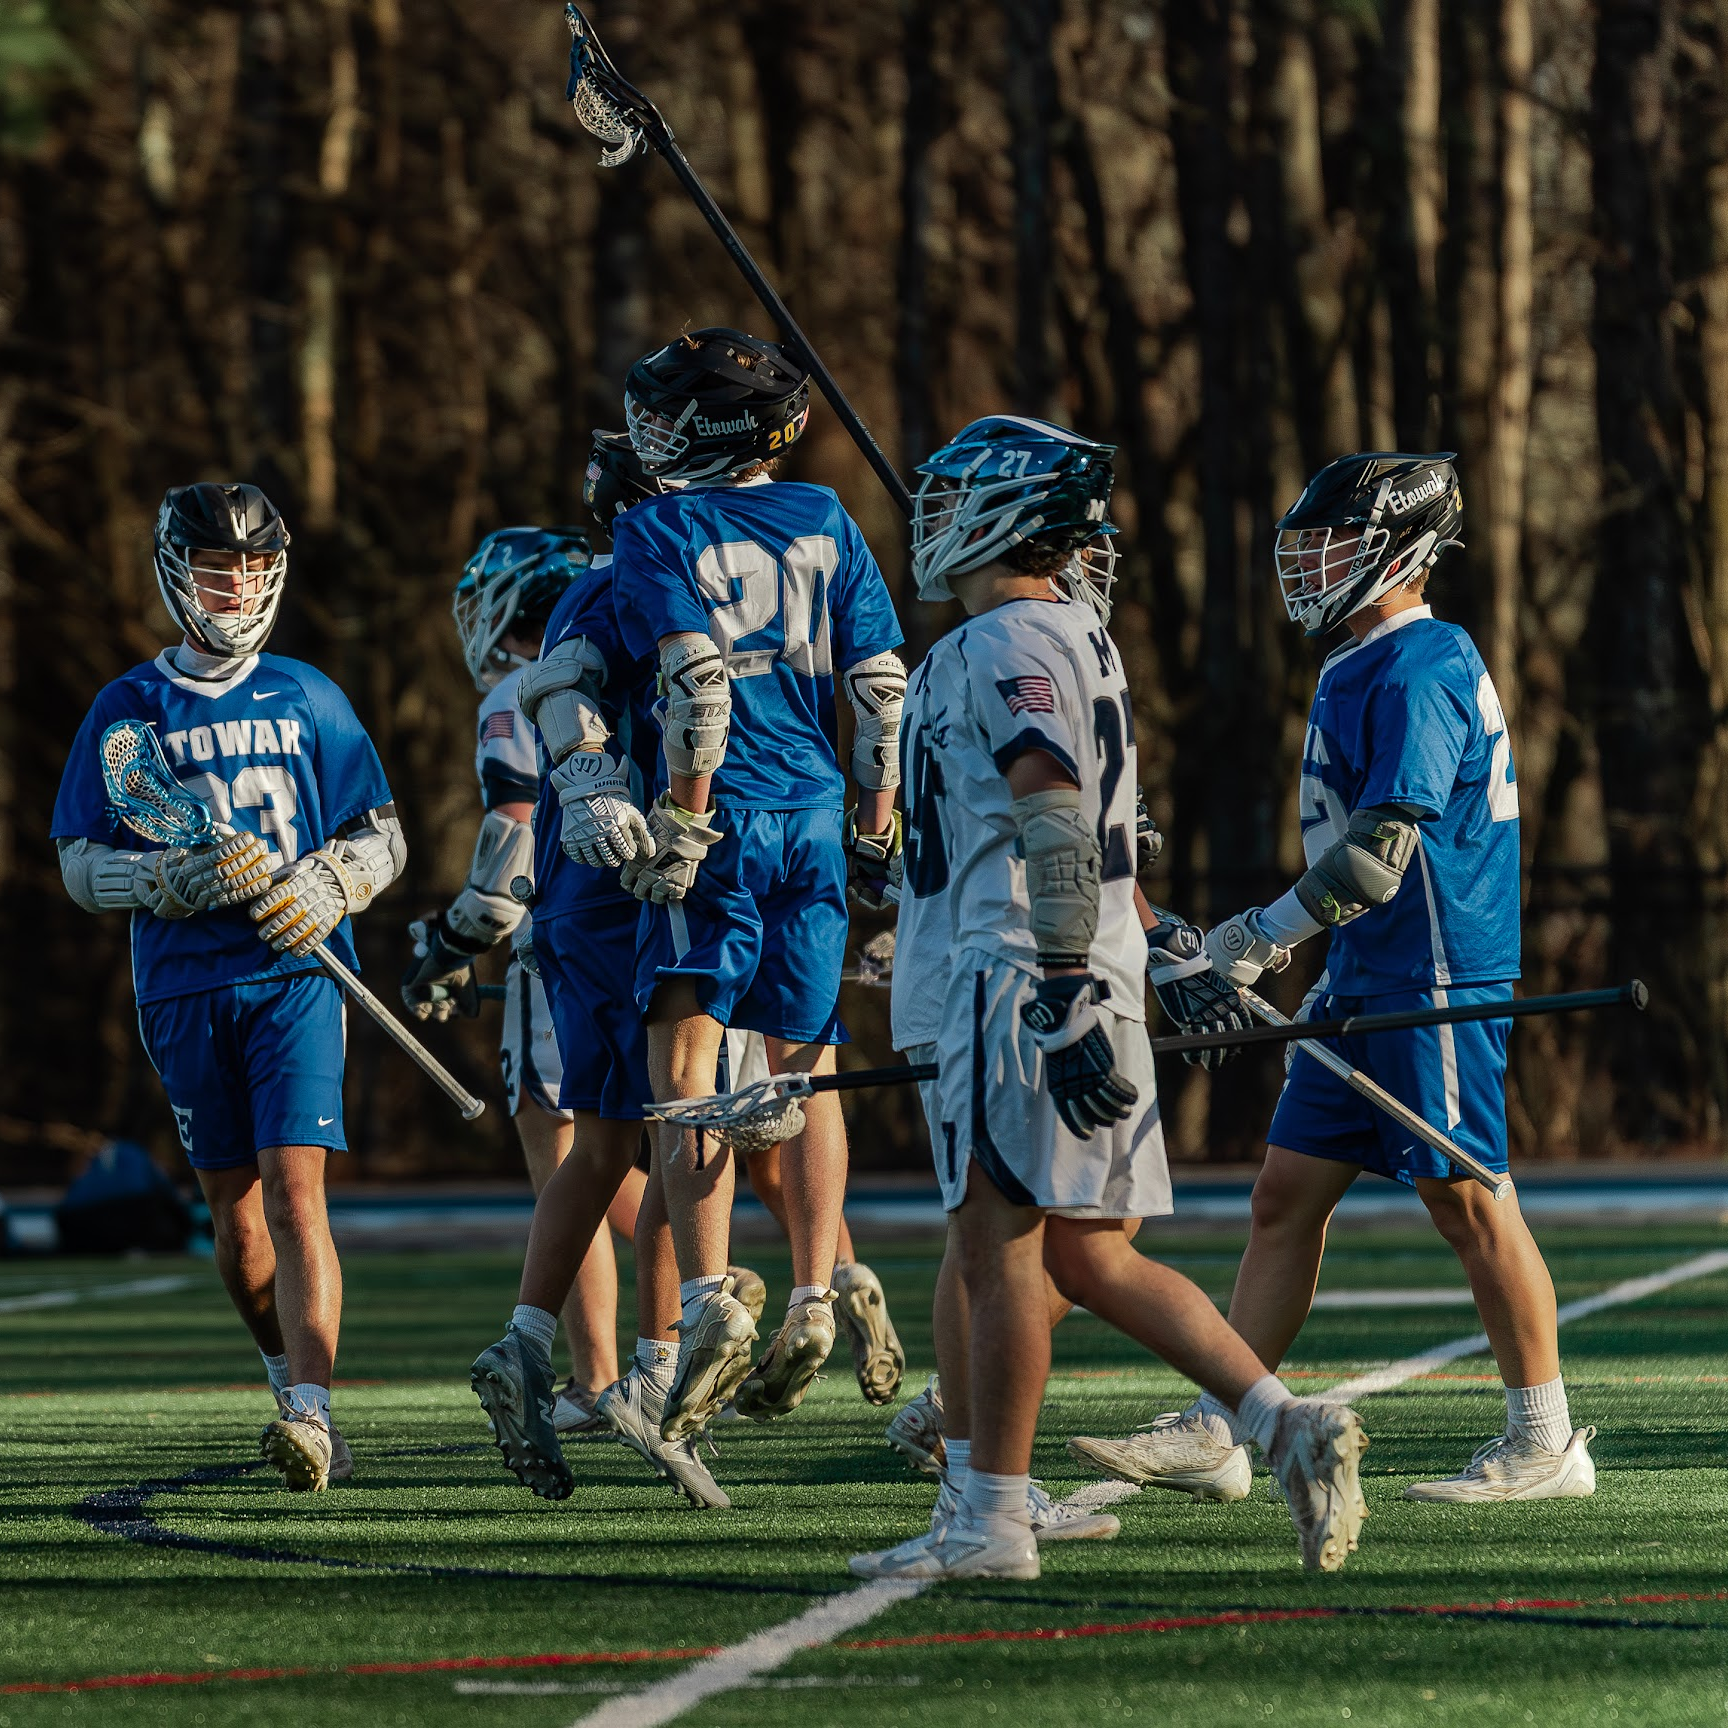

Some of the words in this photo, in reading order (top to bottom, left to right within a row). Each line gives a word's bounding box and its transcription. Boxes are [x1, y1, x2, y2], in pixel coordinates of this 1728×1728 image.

[692, 409, 758, 436] Etowah
[768, 421, 795, 450] 20
[998, 450, 1032, 478] 27
[1387, 469, 1446, 515] Etowah
[696, 535, 839, 678] 20
[161, 718, 302, 767] TOWAH
